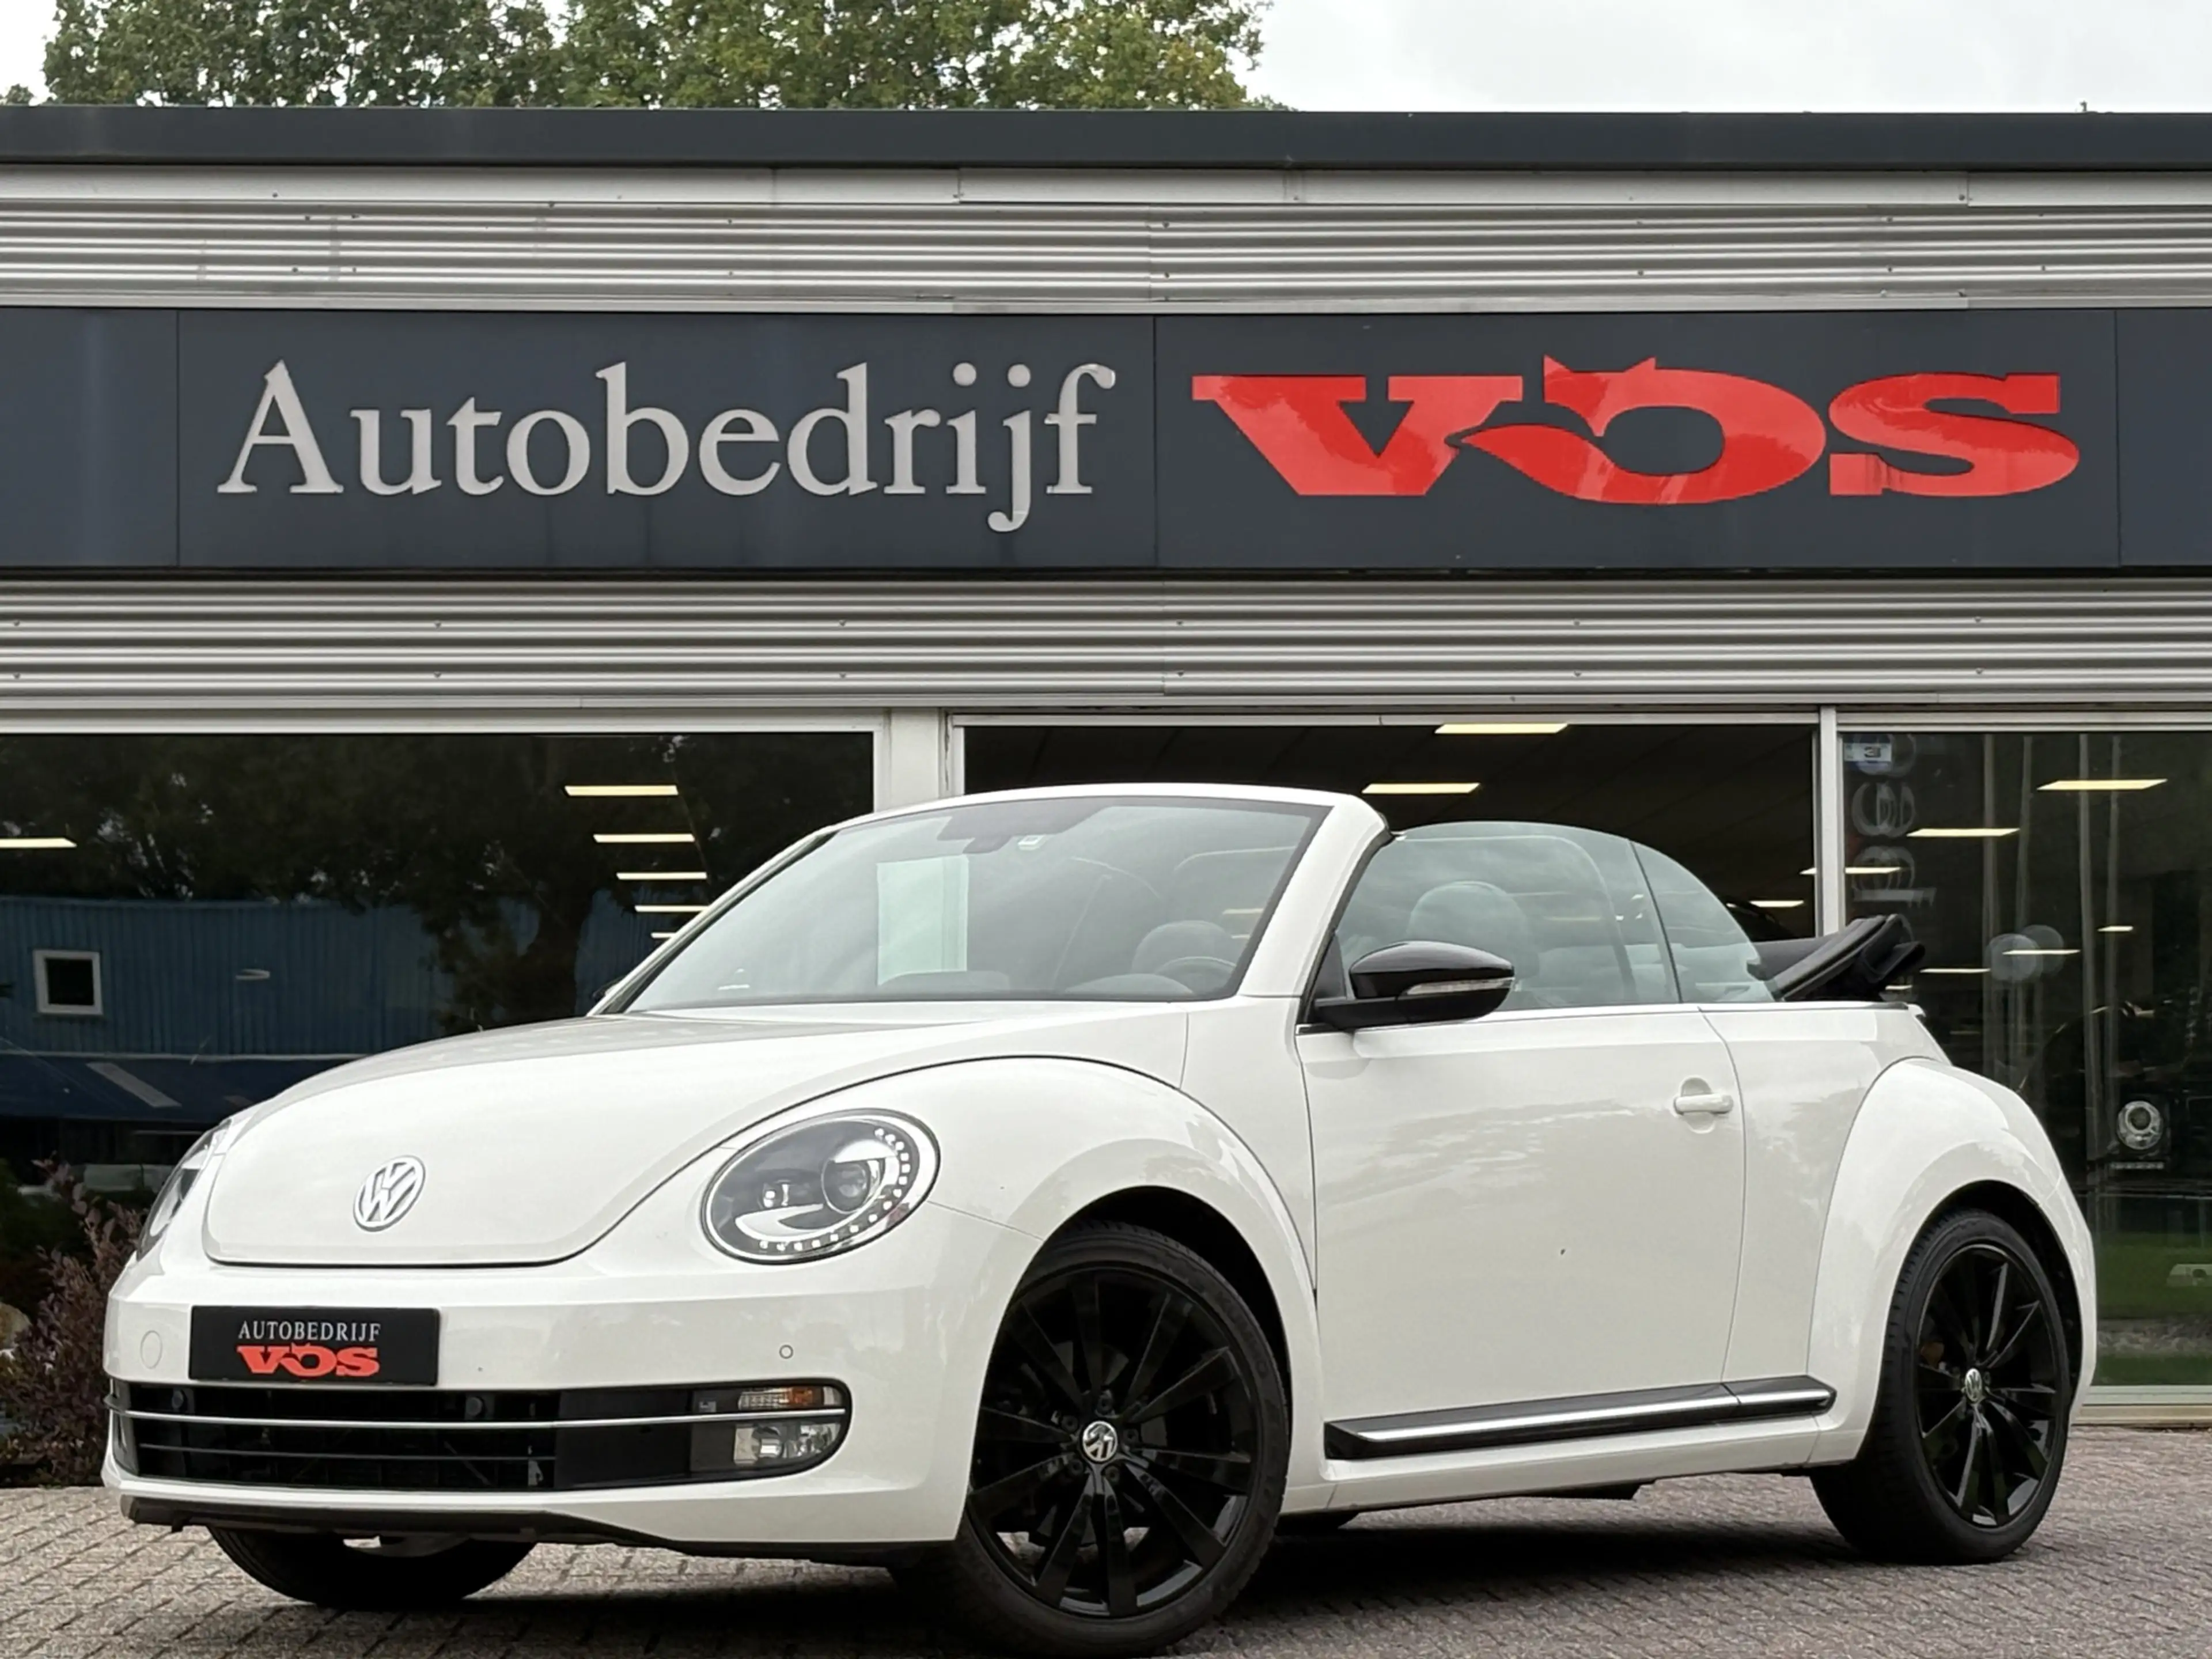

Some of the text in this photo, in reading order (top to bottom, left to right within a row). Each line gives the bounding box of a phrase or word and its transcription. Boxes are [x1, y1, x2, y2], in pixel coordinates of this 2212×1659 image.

[217, 355, 2080, 532] Autobedrijf VOS
[238, 1320, 381, 1342] AUTOBEDRIJF
[236, 1343, 380, 1378] VOS
